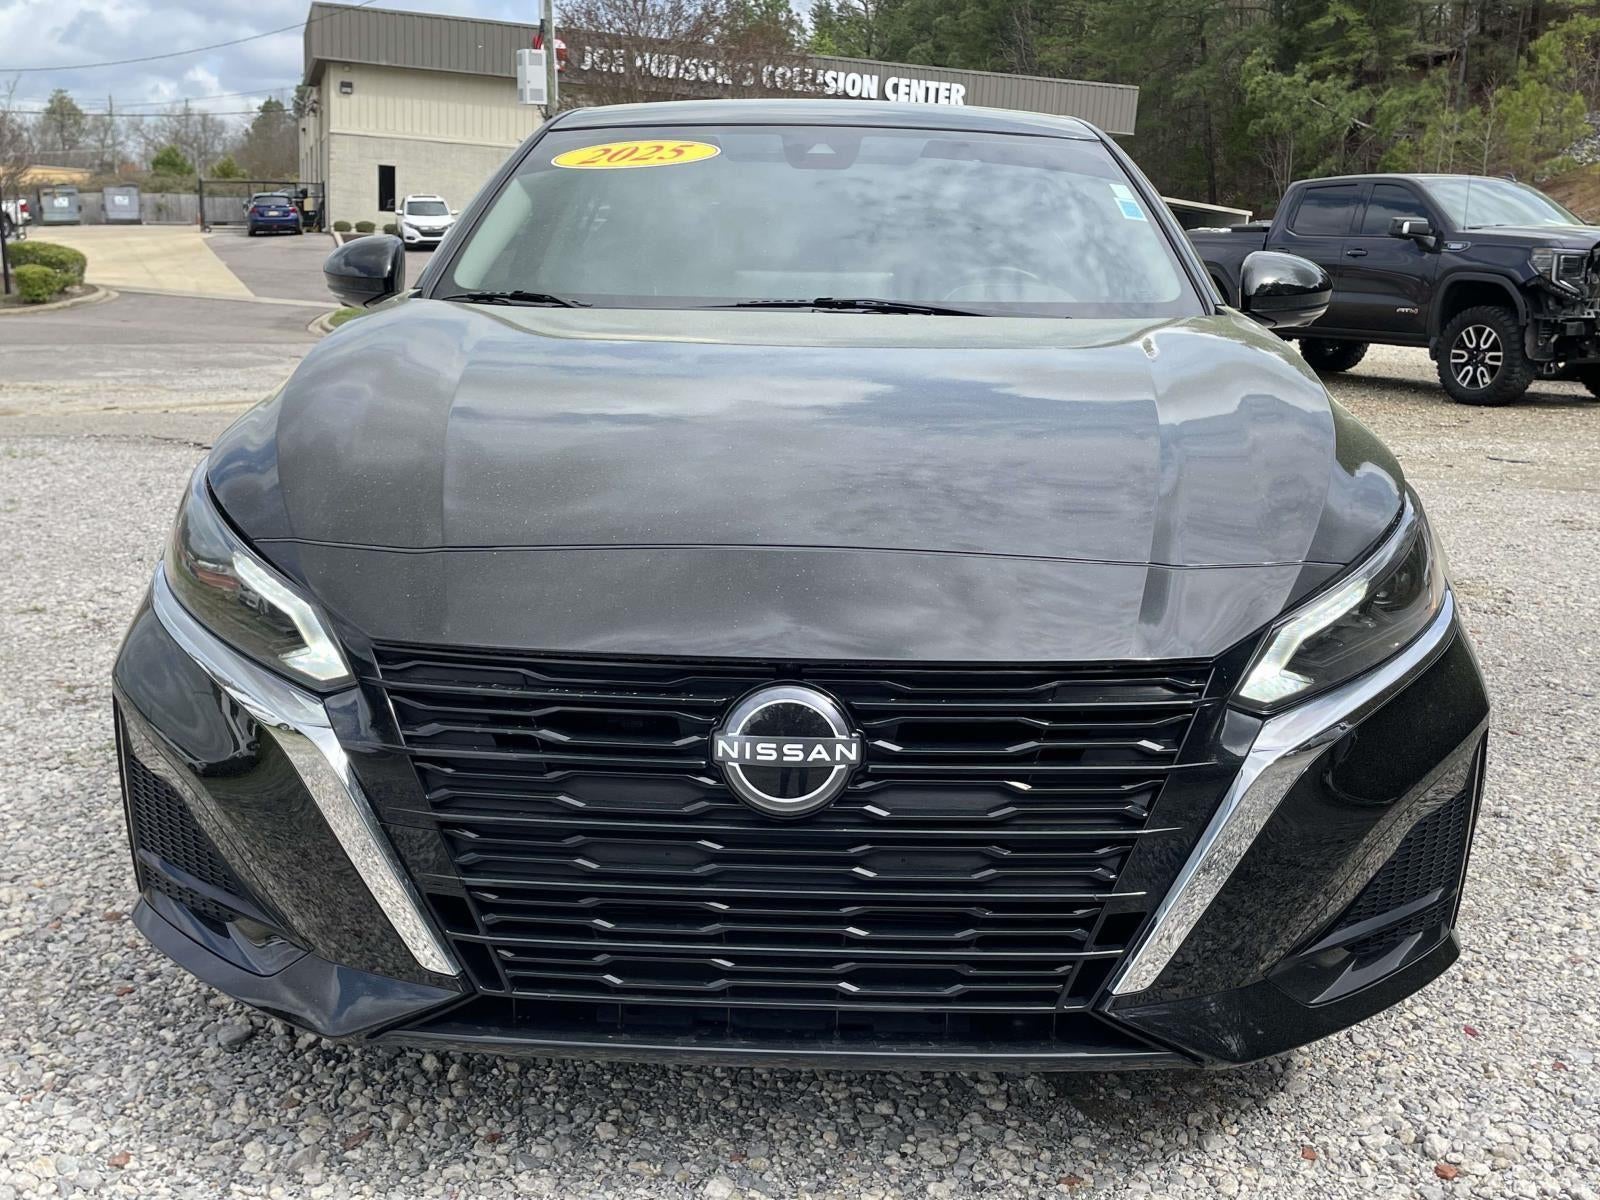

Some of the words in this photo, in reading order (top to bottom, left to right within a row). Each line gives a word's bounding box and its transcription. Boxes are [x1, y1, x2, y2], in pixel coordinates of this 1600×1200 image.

[884, 76, 966, 105] CENTER
[576, 144, 695, 165] 2025
[717, 740, 857, 762] NISSAN
